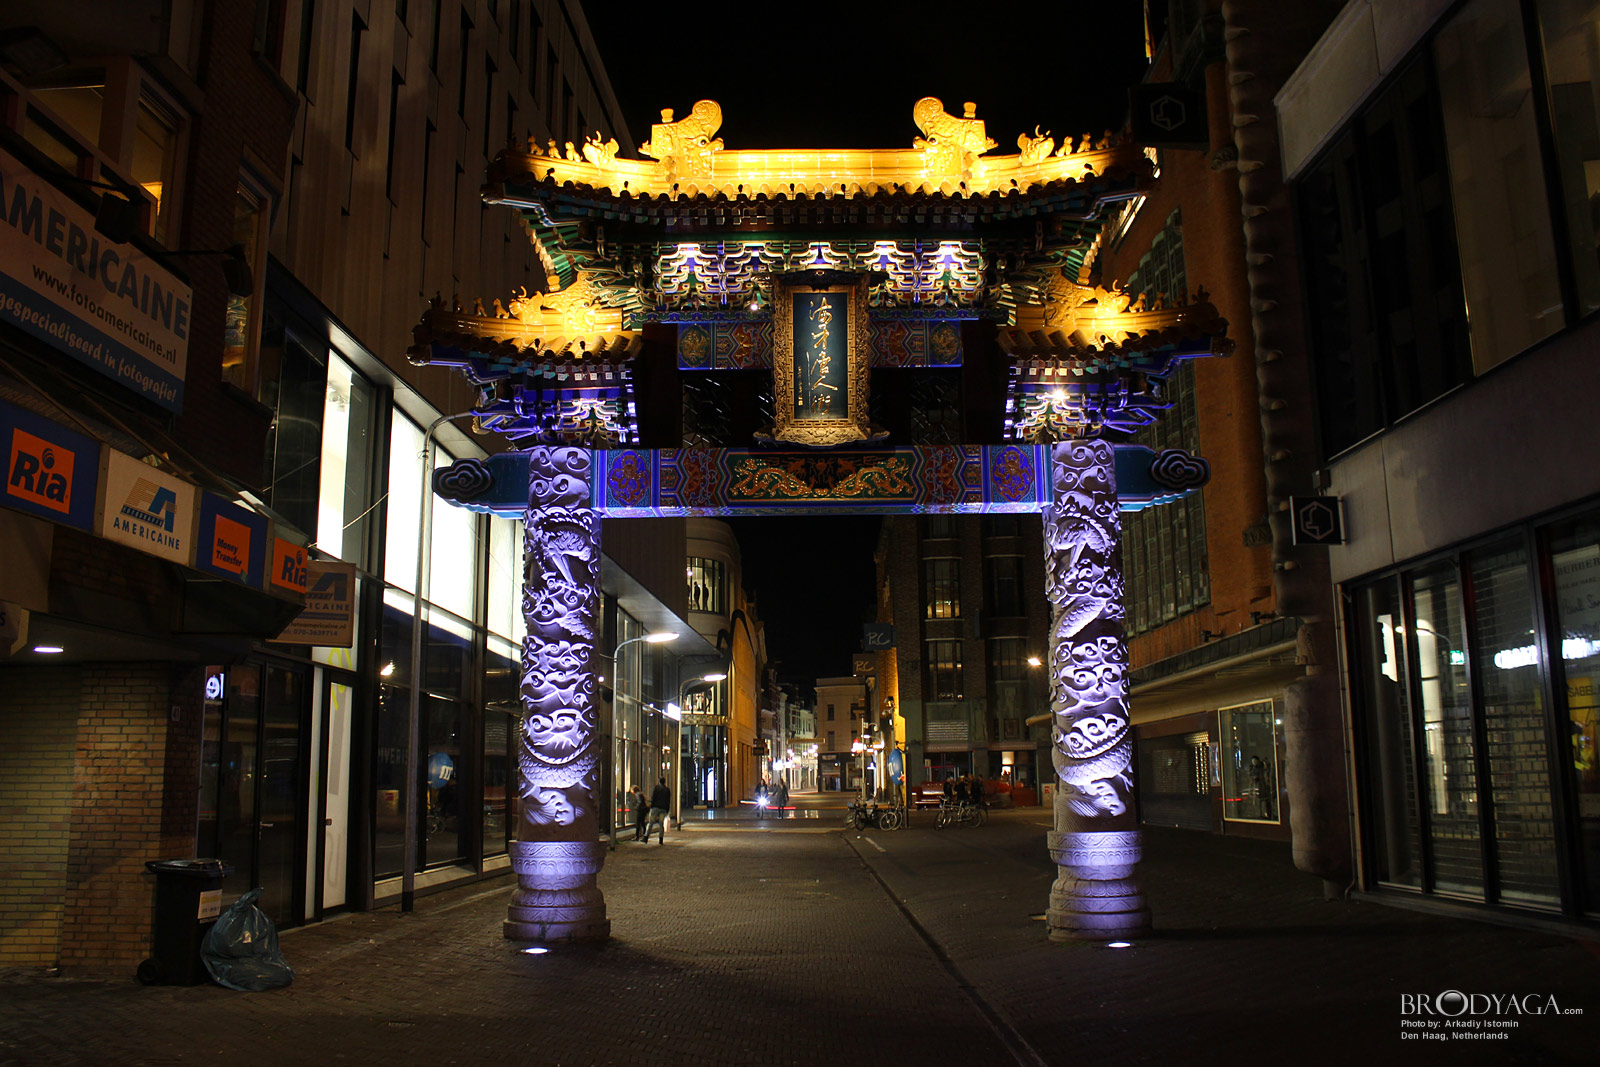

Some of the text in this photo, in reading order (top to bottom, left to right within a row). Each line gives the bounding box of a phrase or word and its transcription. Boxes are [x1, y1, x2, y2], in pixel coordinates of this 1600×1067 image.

[33, 265, 176, 364] www.fotoamericaine.nl
[104, 349, 117, 368] in
[118, 358, 176, 403] fotografie!
[10, 448, 67, 503] Ria
[114, 517, 180, 549] AMERICAINE
[217, 538, 238, 554] Money
[216, 550, 241, 566] Transfer
[281, 550, 307, 588] Ria
